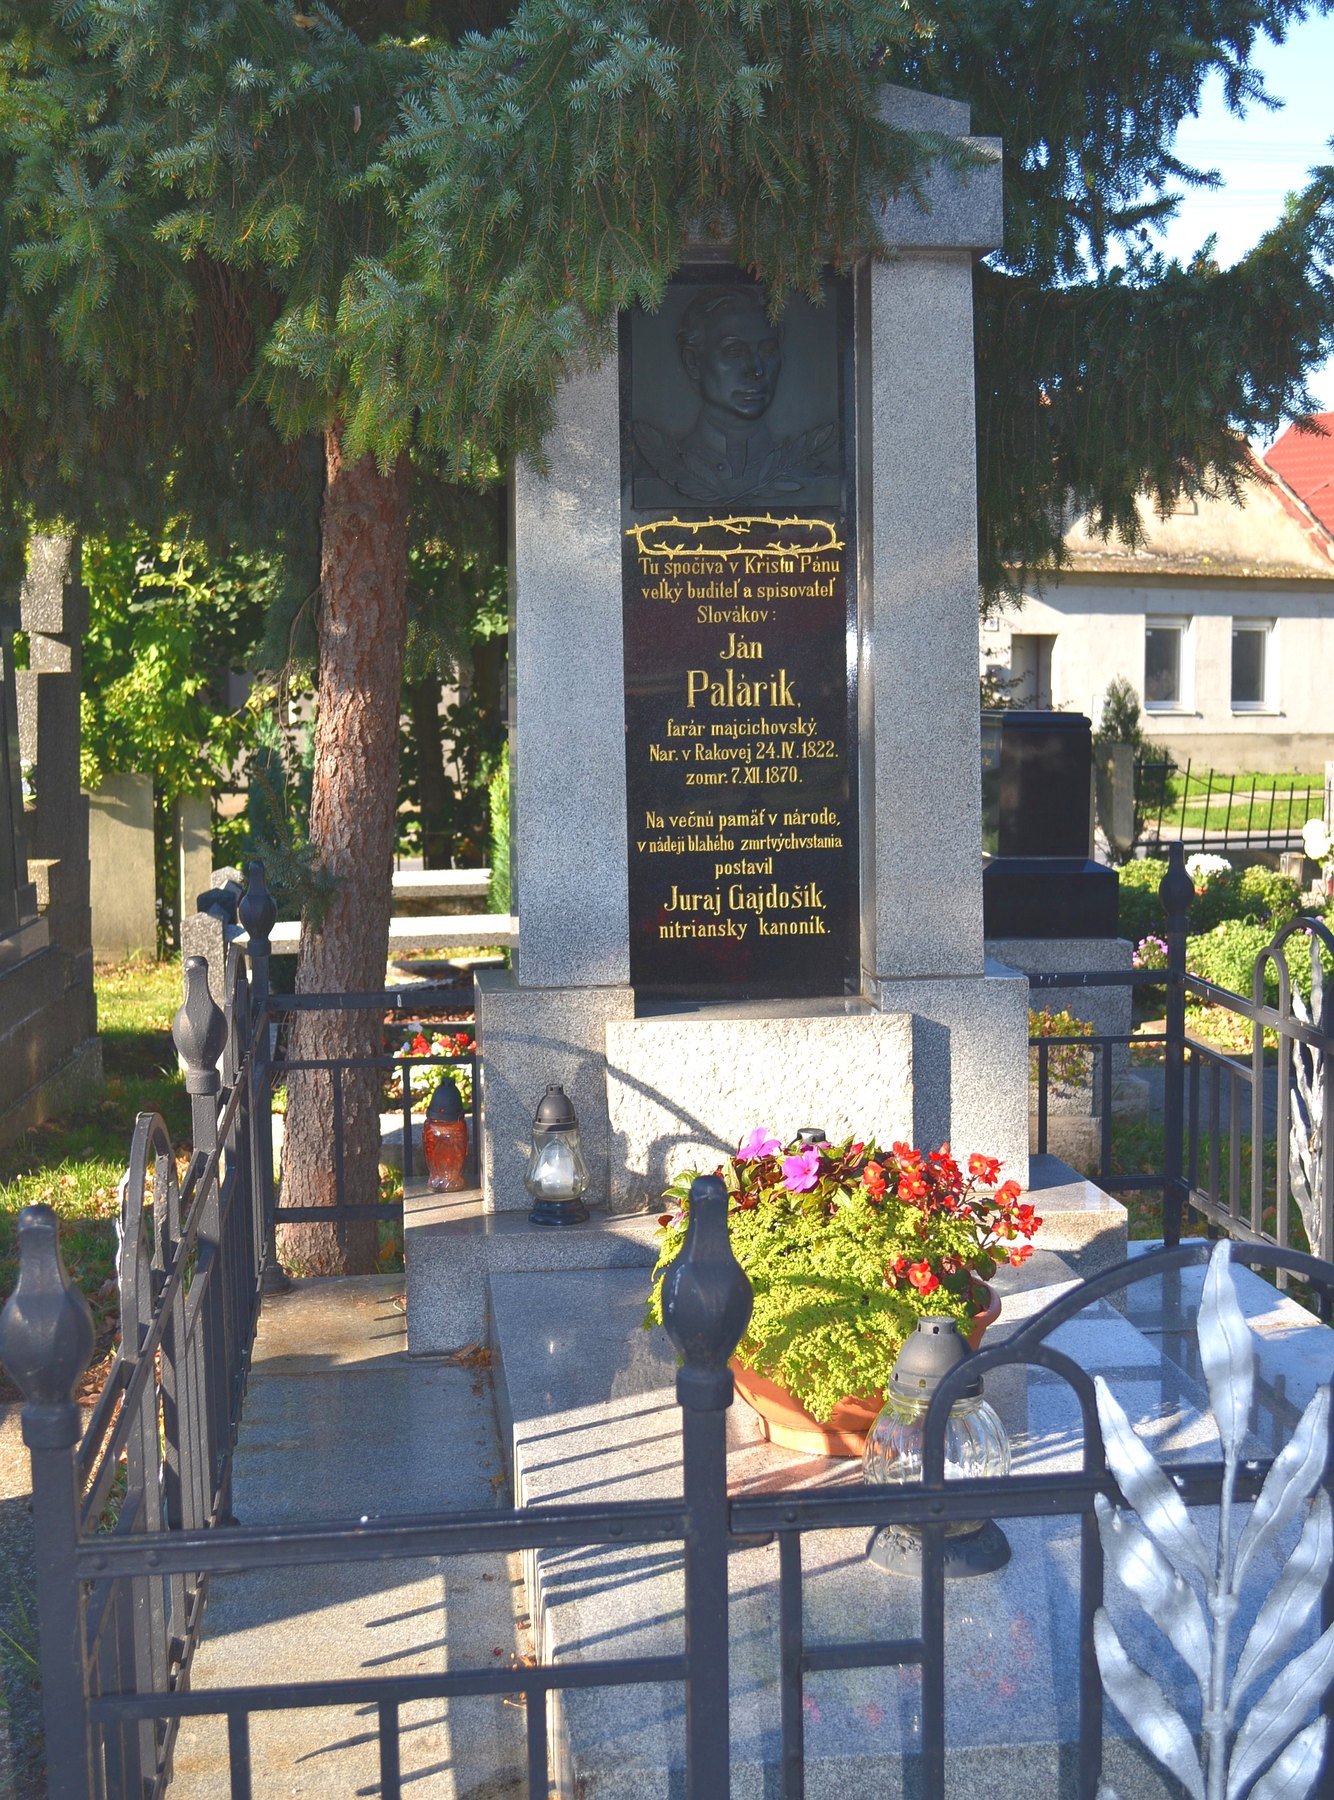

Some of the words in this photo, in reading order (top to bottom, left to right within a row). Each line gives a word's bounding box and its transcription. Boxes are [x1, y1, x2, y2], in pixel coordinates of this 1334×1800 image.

[638, 558, 659, 575] Tu
[664, 557, 724, 577] spočíva
[730, 562, 739, 574] v
[745, 556, 793, 574] Kristu
[800, 555, 840, 573] Pánu
[687, 578, 741, 599] buditeľ
[744, 587, 752, 597] a
[757, 577, 836, 601] spisovateľ
[720, 633, 763, 659] Ján
[687, 669, 801, 708] Palárik,
[667, 718, 705, 737] farár
[711, 717, 818, 739] majcichovský.
[649, 744, 678, 761] Nar.
[682, 750, 691, 760] v
[695, 743, 751, 764] Rakovej
[686, 773, 728, 785] zomr.
[646, 812, 664, 828] Na
[669, 811, 713, 828] večnú
[768, 814, 778, 826] v
[783, 807, 840, 826] národe,
[637, 841, 646, 852] v
[649, 836, 685, 854] nádeji
[688, 835, 734, 851] blahého
[740, 833, 842, 852] zmrtvýchvstania
[715, 857, 773, 879] postavil
[664, 885, 720, 915] Juraj
[729, 883, 827, 914] Gajdošík,
[659, 919, 747, 940] nitriansky
[759, 916, 830, 936] kanoník.
